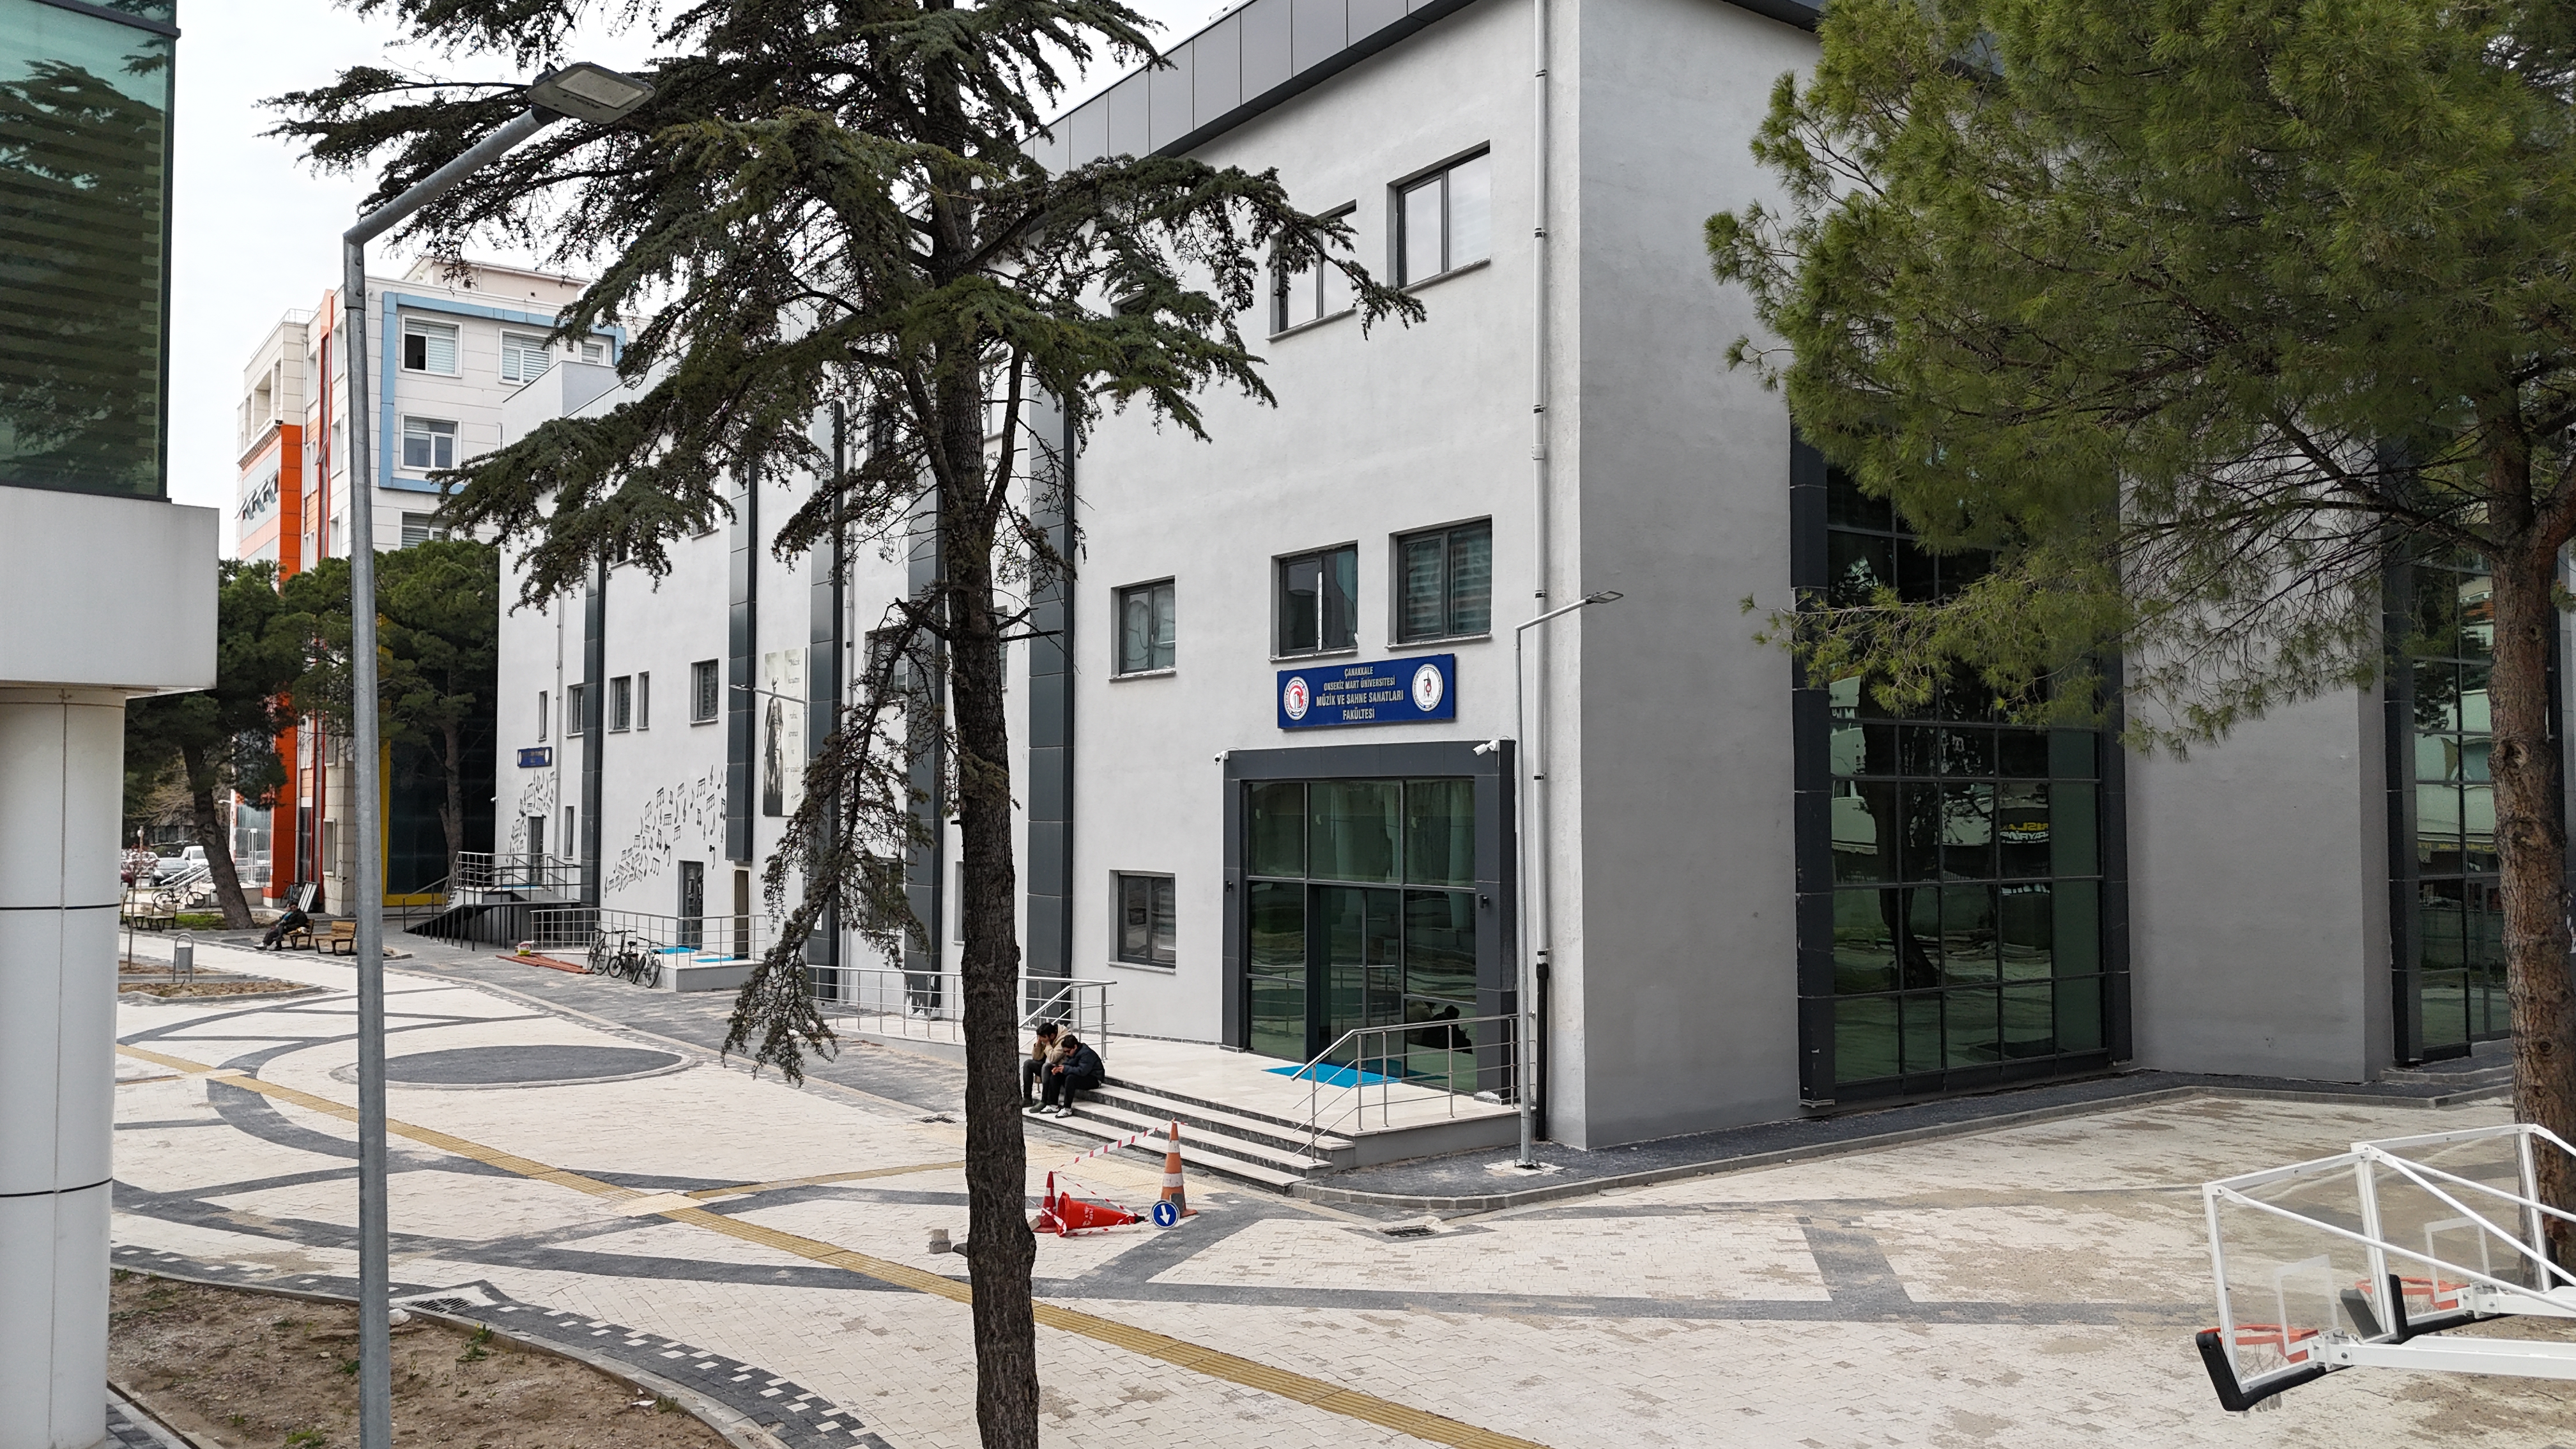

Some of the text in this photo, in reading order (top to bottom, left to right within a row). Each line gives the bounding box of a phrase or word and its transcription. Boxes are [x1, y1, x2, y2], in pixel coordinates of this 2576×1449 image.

[1344, 666, 1374, 679] ÇANAKKALE
[1324, 675, 1395, 691] ONSEKİZ MART ÜNİVERSİTESİ
[1316, 690, 1404, 707] MÜZİK VE SAHNE SANATLARI
[1342, 706, 1375, 721] FAKÜLTESİ
